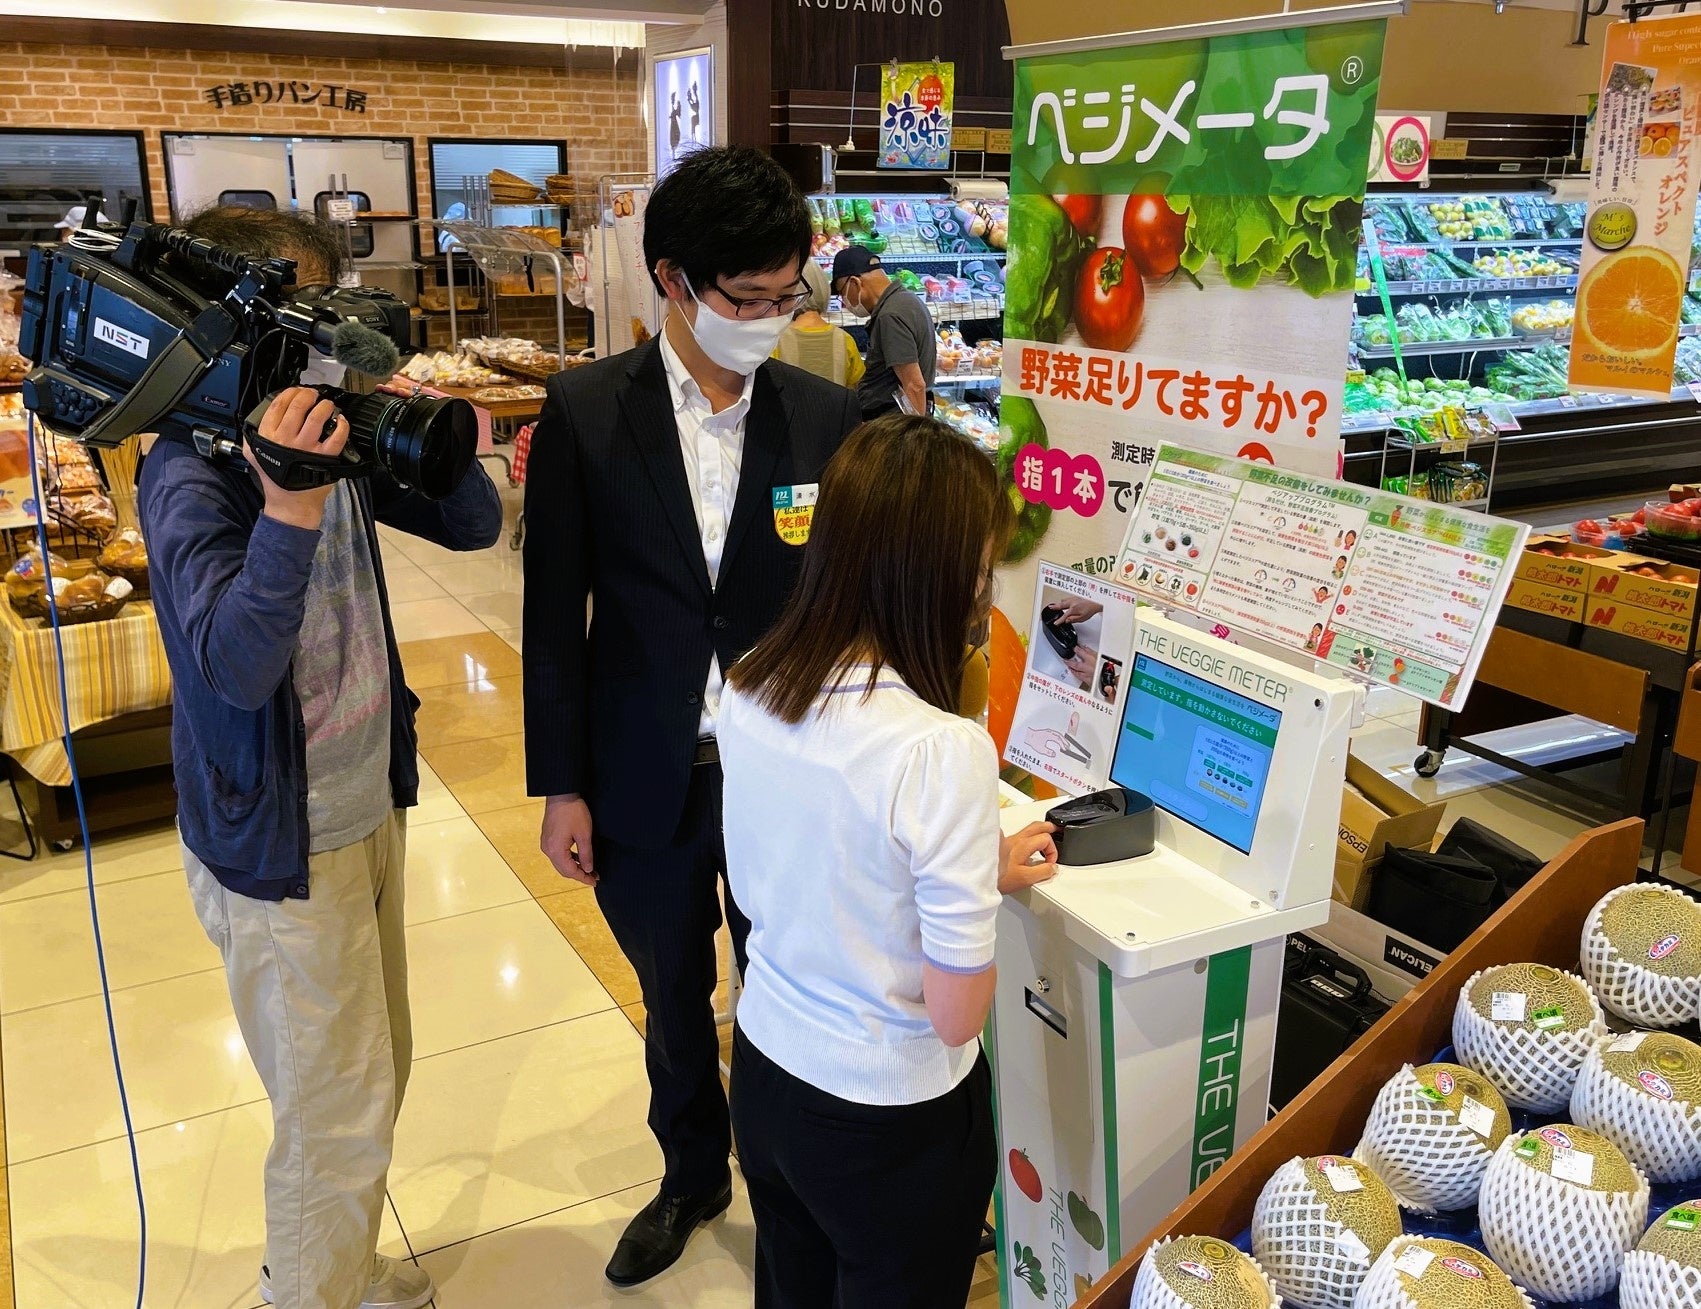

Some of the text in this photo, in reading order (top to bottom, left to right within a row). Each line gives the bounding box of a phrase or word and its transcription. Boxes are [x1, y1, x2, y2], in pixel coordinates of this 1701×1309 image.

[205, 80, 368, 114] 手造りパン工房
[884, 91, 949, 152] 涼味
[1027, 74, 1331, 165] ベジメータ
[1654, 175, 1673, 237] オレンジ
[102, 325, 143, 350] NST
[1019, 348, 1328, 438] 野菜足りてますか?
[255, 447, 281, 467] Canon
[1140, 629, 1168, 660] THE
[1171, 642, 1226, 678] VEGGIE
[1228, 666, 1288, 703] METER
[1390, 946, 1433, 973] ELICAN
[1201, 1018, 1239, 1116] THE
[1049, 1187, 1065, 1240] THE
